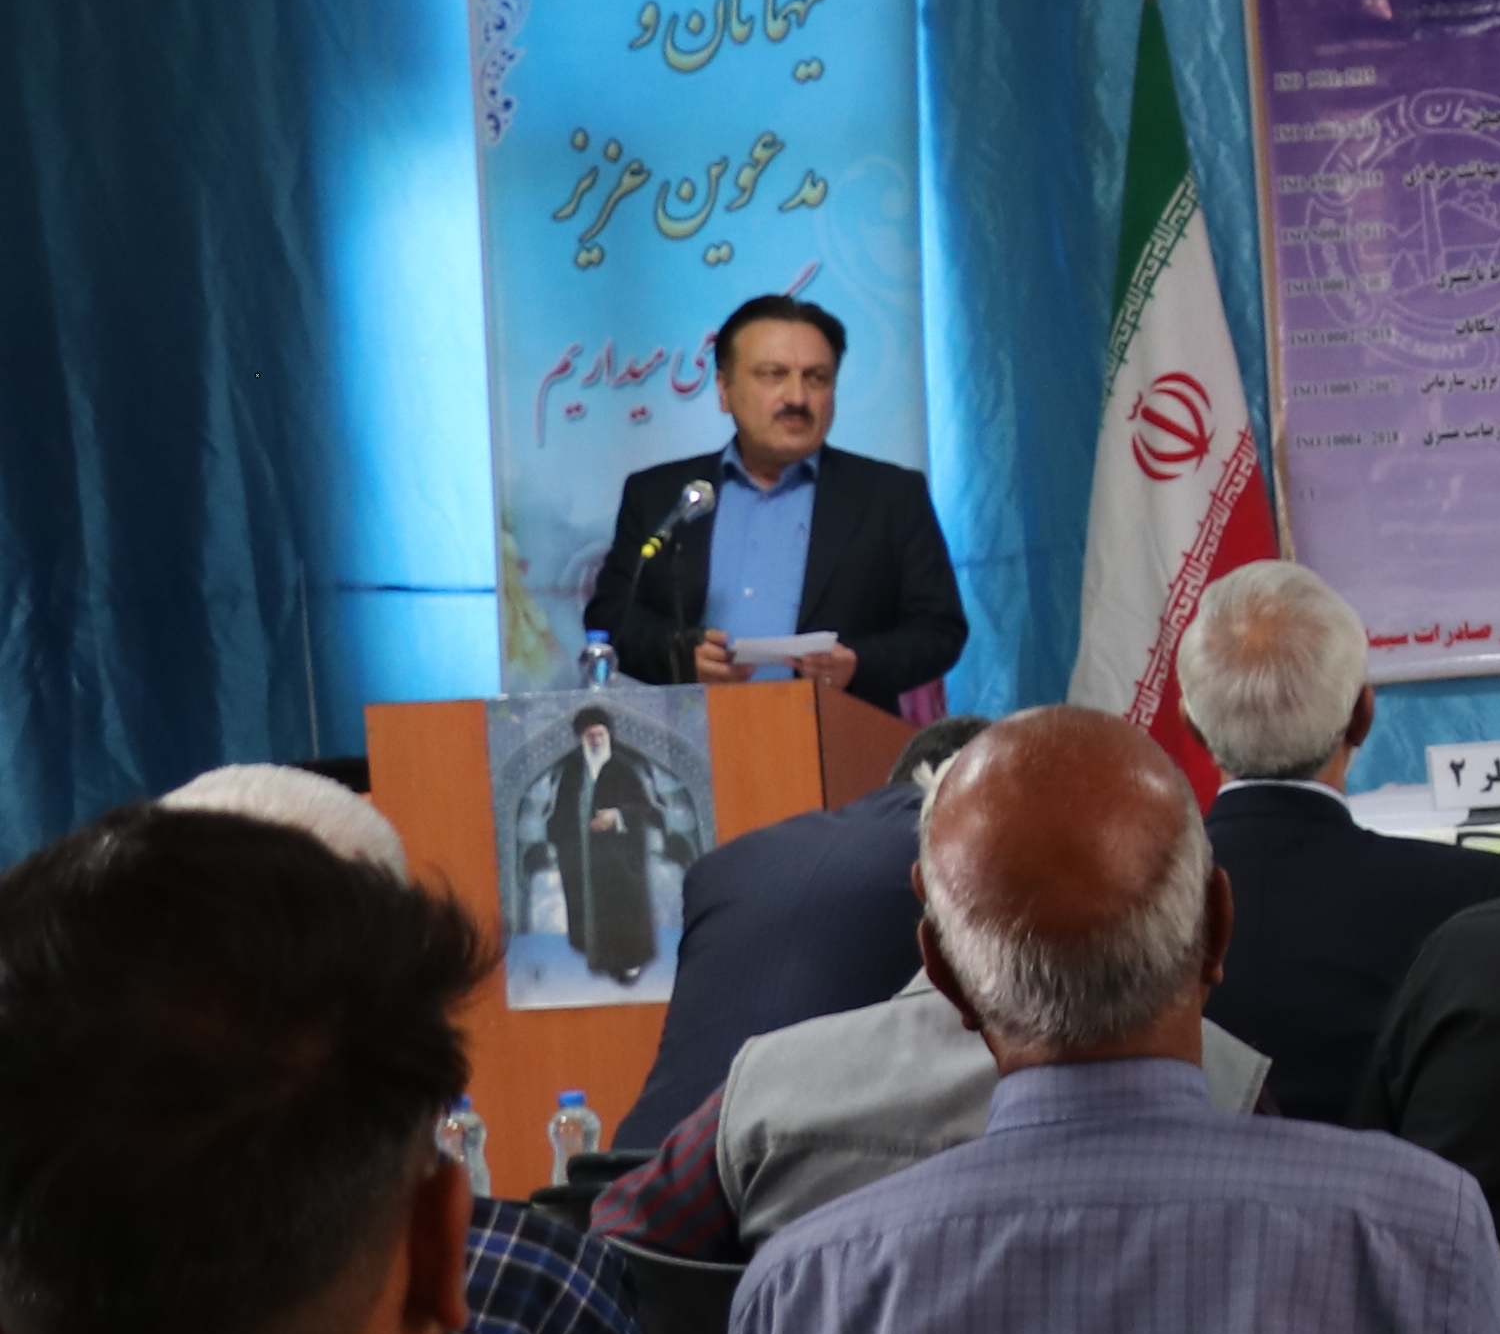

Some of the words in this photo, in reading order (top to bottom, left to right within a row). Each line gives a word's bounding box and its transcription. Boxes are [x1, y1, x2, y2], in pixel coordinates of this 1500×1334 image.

[628, 0, 661, 51] و
[551, 126, 650, 268] عزیز
[653, 129, 829, 266] مدعوین
[1367, 625, 1409, 652] سیما
[1448, 758, 1467, 788] ۲
